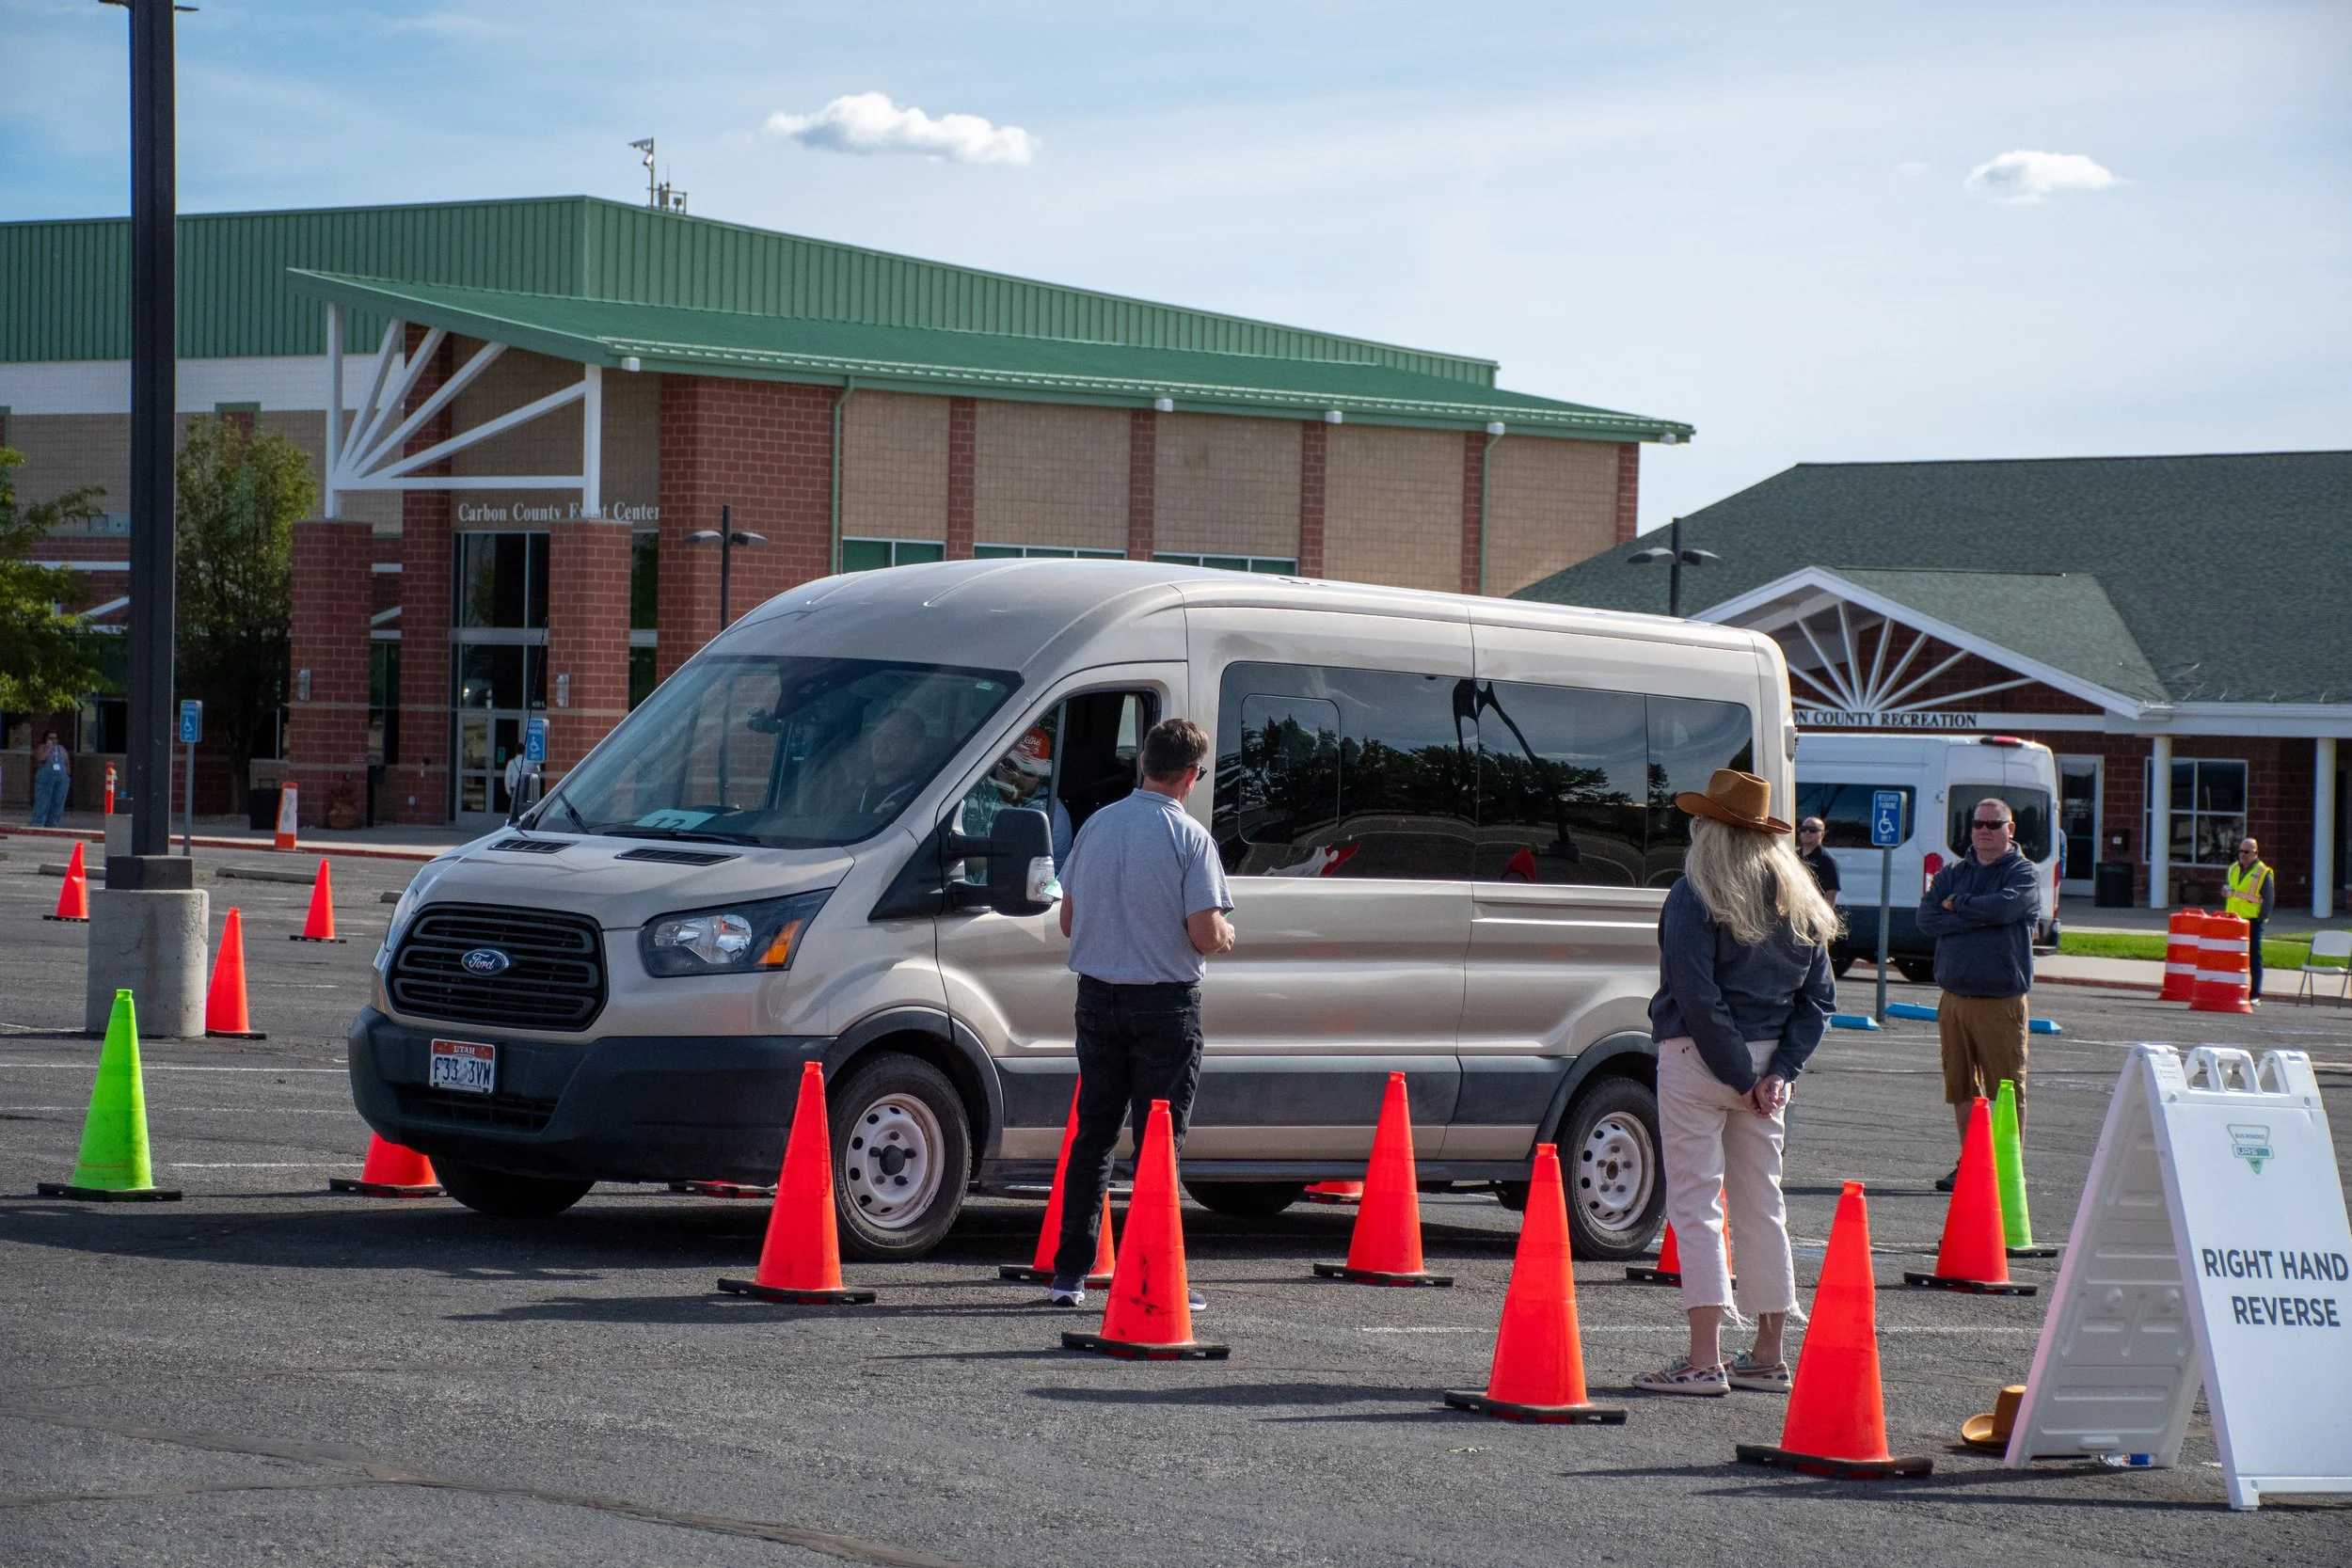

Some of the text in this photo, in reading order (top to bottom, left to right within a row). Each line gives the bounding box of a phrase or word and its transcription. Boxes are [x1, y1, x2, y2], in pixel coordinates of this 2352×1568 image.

[458, 500, 660, 522] Carbon County Evt Center
[1814, 711, 1875, 725] COUNTY
[1881, 712, 1977, 727] RECREATION
[469, 952, 496, 970] Ford
[453, 1045, 475, 1054] UTAH
[435, 1056, 459, 1081] F33
[2201, 1248, 2350, 1282] RIGHT HAND
[2231, 1295, 2342, 1328] REVERSE
